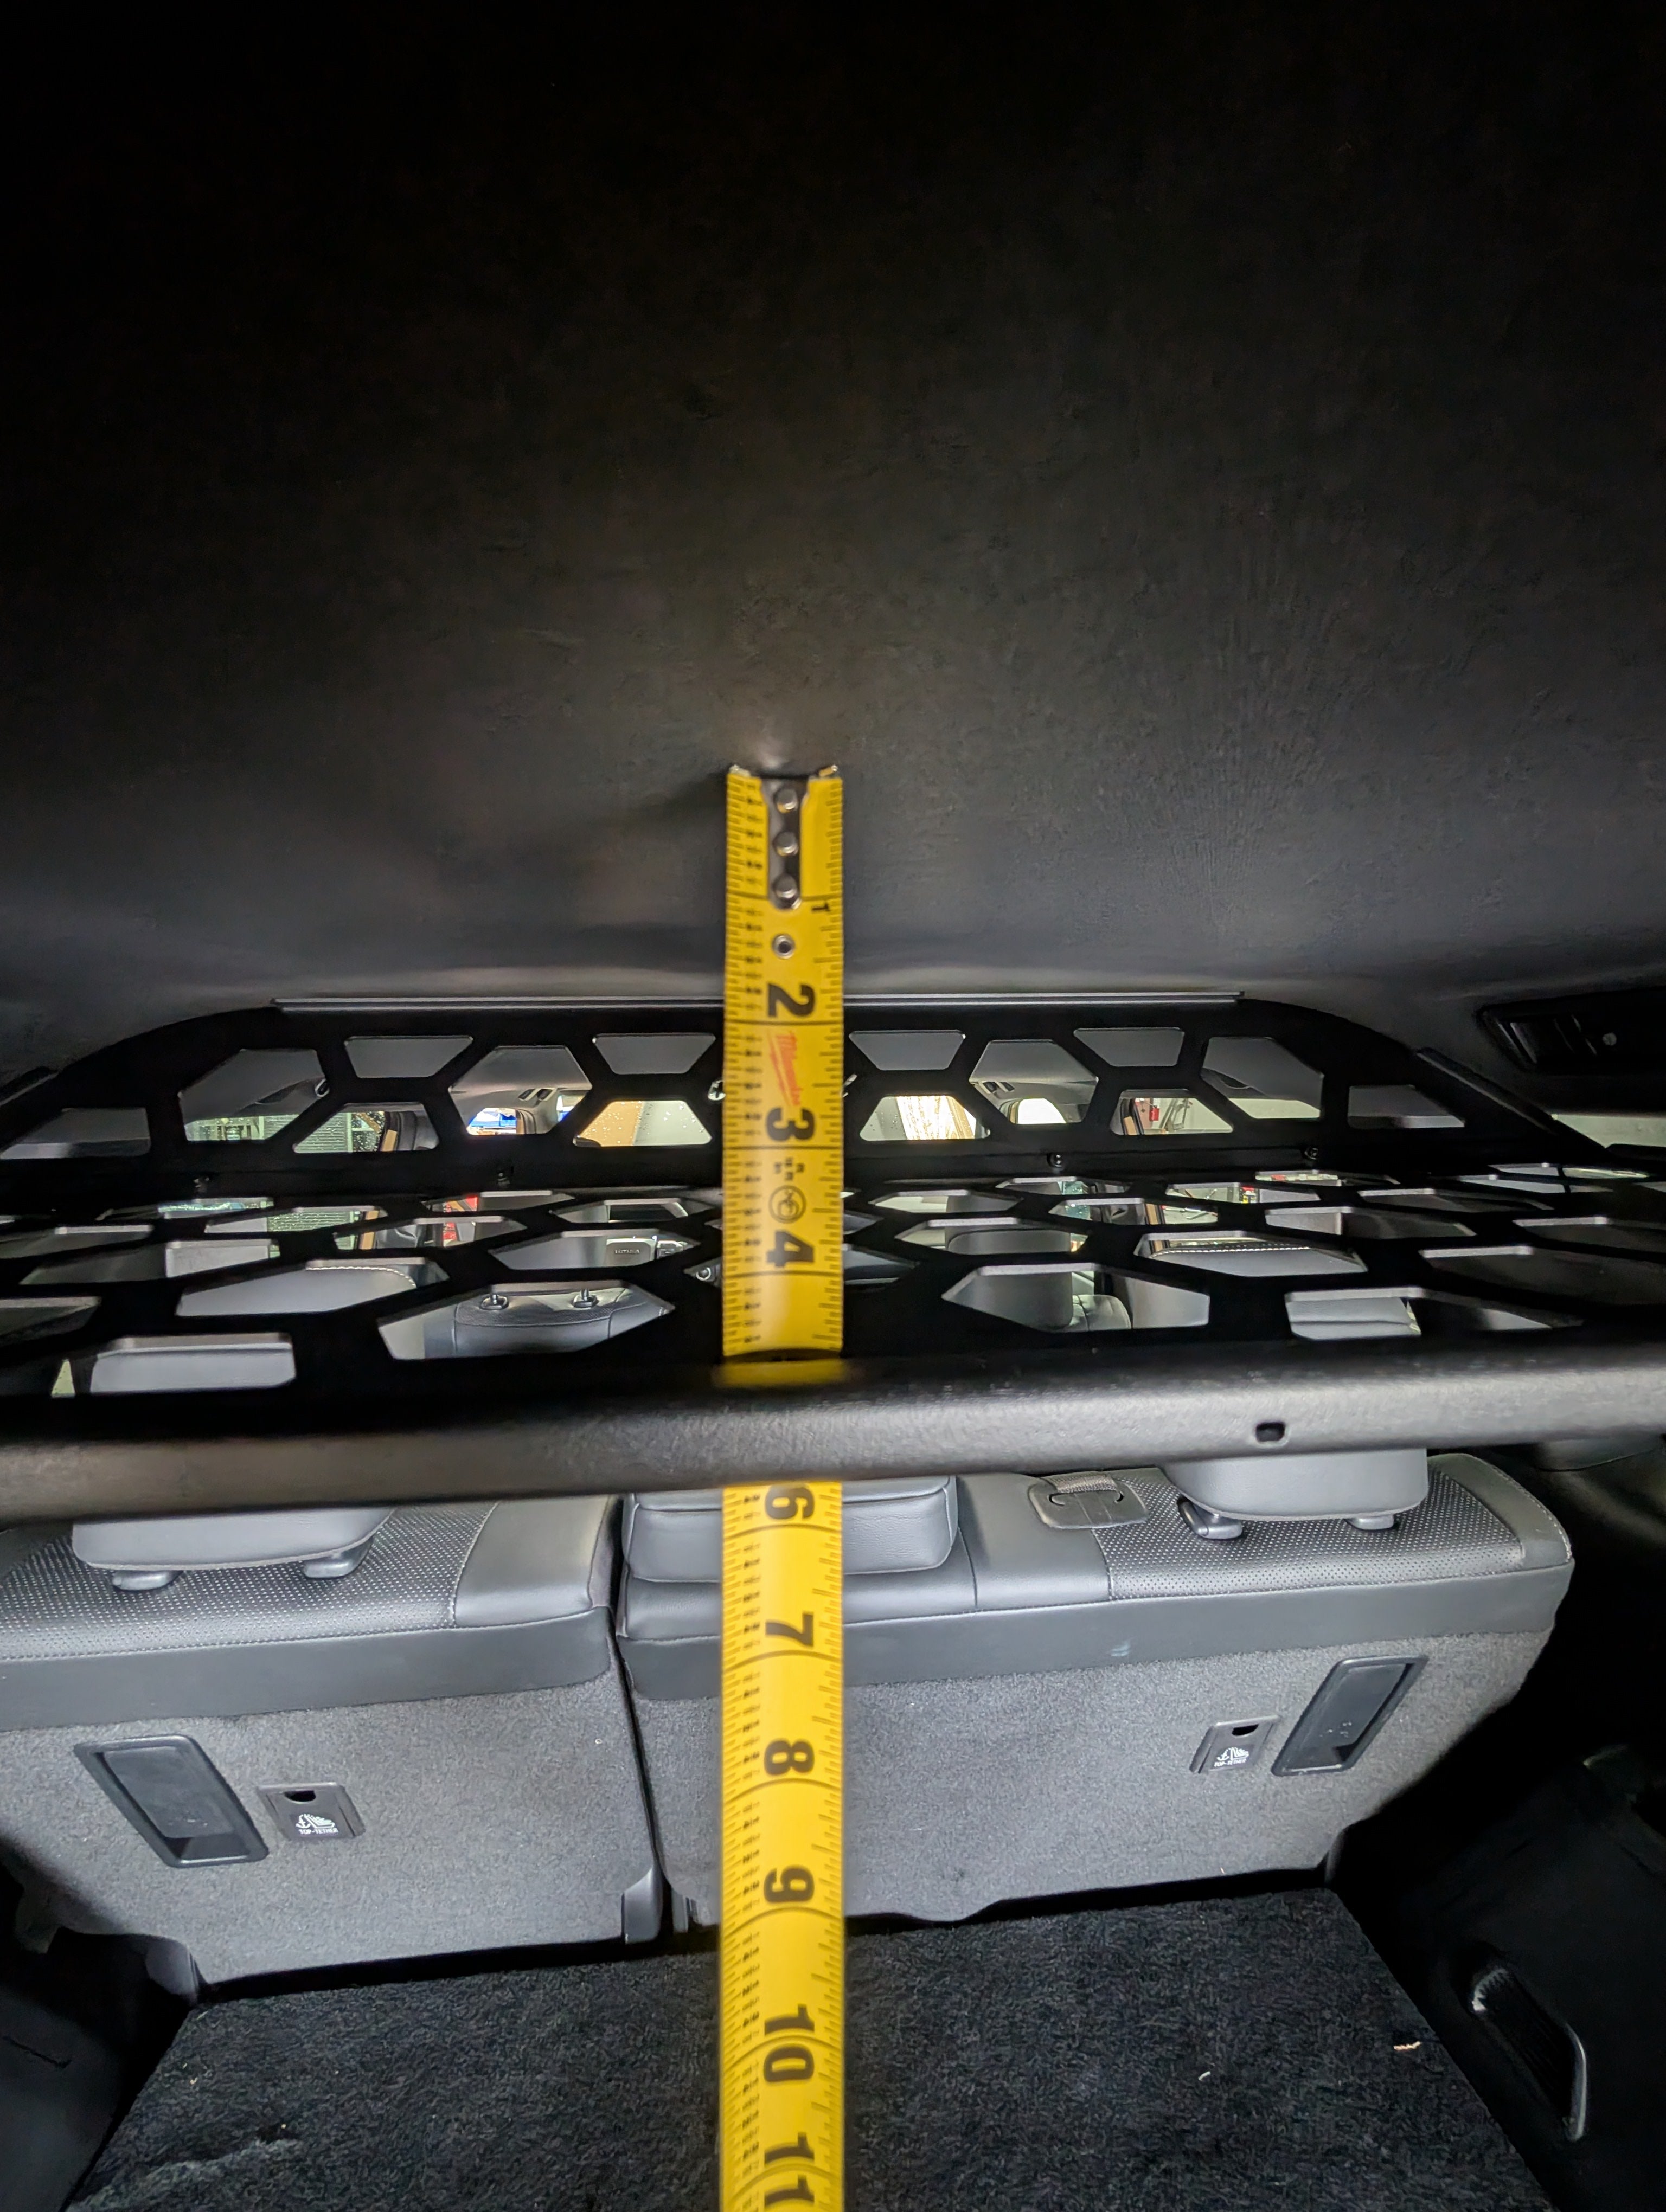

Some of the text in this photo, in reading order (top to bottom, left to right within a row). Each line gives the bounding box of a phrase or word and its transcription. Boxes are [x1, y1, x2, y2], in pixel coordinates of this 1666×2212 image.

[810, 901, 831, 914] 1
[767, 983, 816, 1018] 2
[765, 1107, 815, 1142] 3
[766, 1231, 815, 1268] 4
[765, 1484, 815, 1520] 6
[765, 1611, 815, 1647] 7
[764, 1739, 815, 1776] 8
[764, 1865, 815, 1904] 9
[764, 2004, 815, 2082] 10
[764, 2131, 815, 2206] 11
